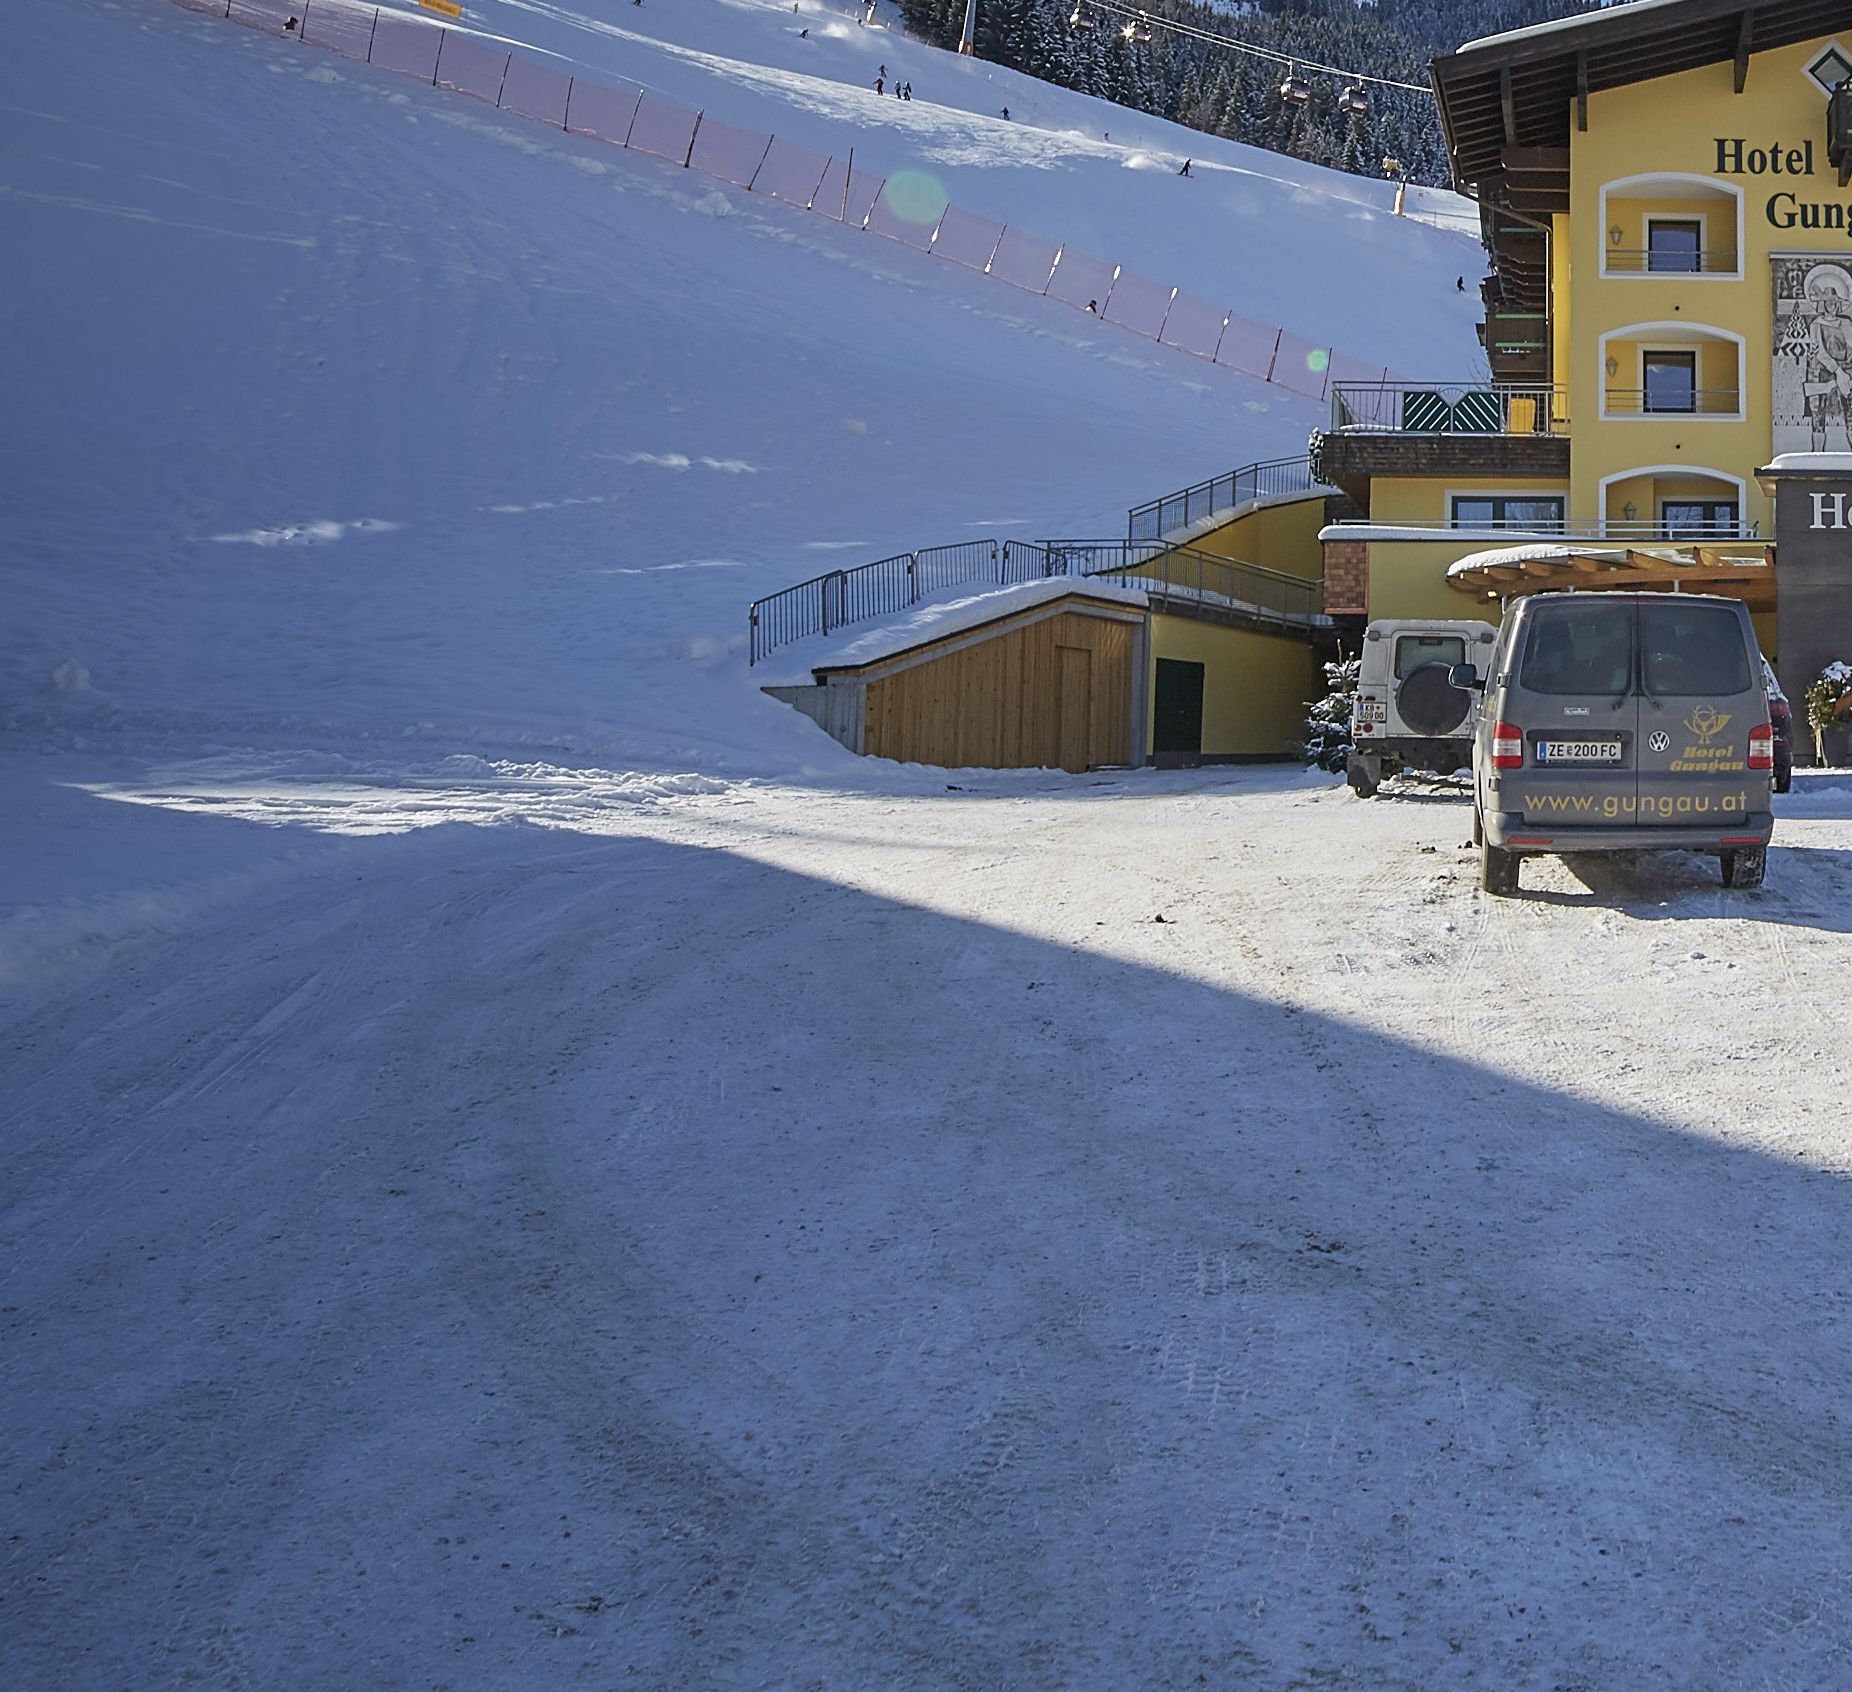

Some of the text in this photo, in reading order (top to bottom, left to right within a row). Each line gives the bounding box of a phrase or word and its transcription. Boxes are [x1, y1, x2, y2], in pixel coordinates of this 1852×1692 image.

[1713, 138, 1815, 175] Hotel
[1549, 744, 1617, 757] ZE 200 FC
[1684, 745, 1733, 758] Hotel
[1670, 759, 1744, 774] Gungau
[1524, 791, 1747, 818] www.gungau.at
